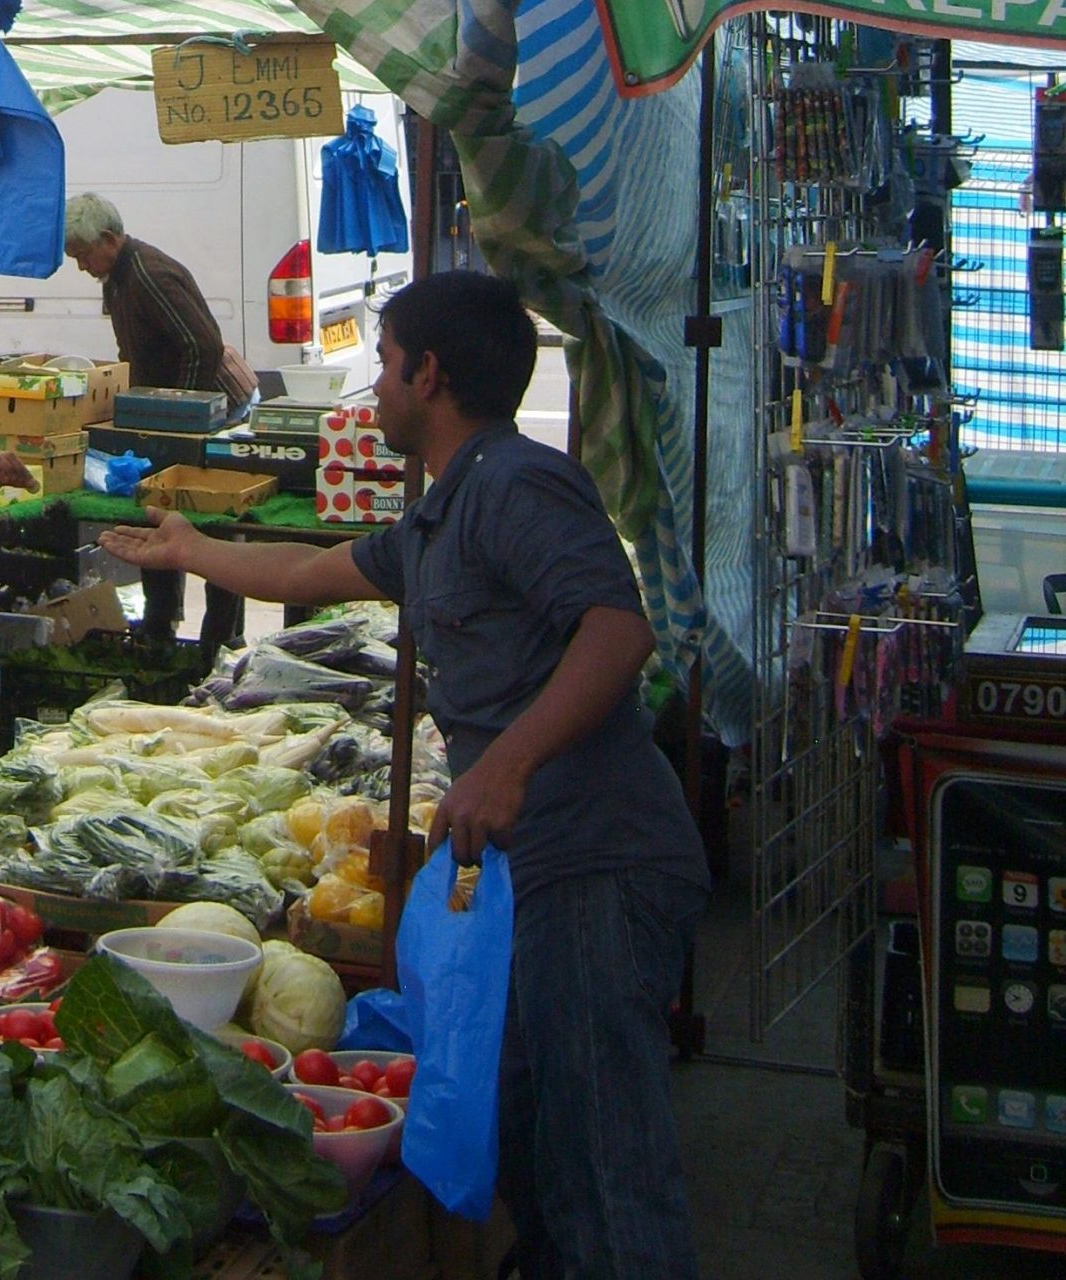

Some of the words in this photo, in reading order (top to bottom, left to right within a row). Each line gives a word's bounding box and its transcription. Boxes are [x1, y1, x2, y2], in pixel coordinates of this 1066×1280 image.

[223, 86, 323, 123] 12365
[230, 442, 306, 461] erika
[977, 681, 1066, 717] 0790
